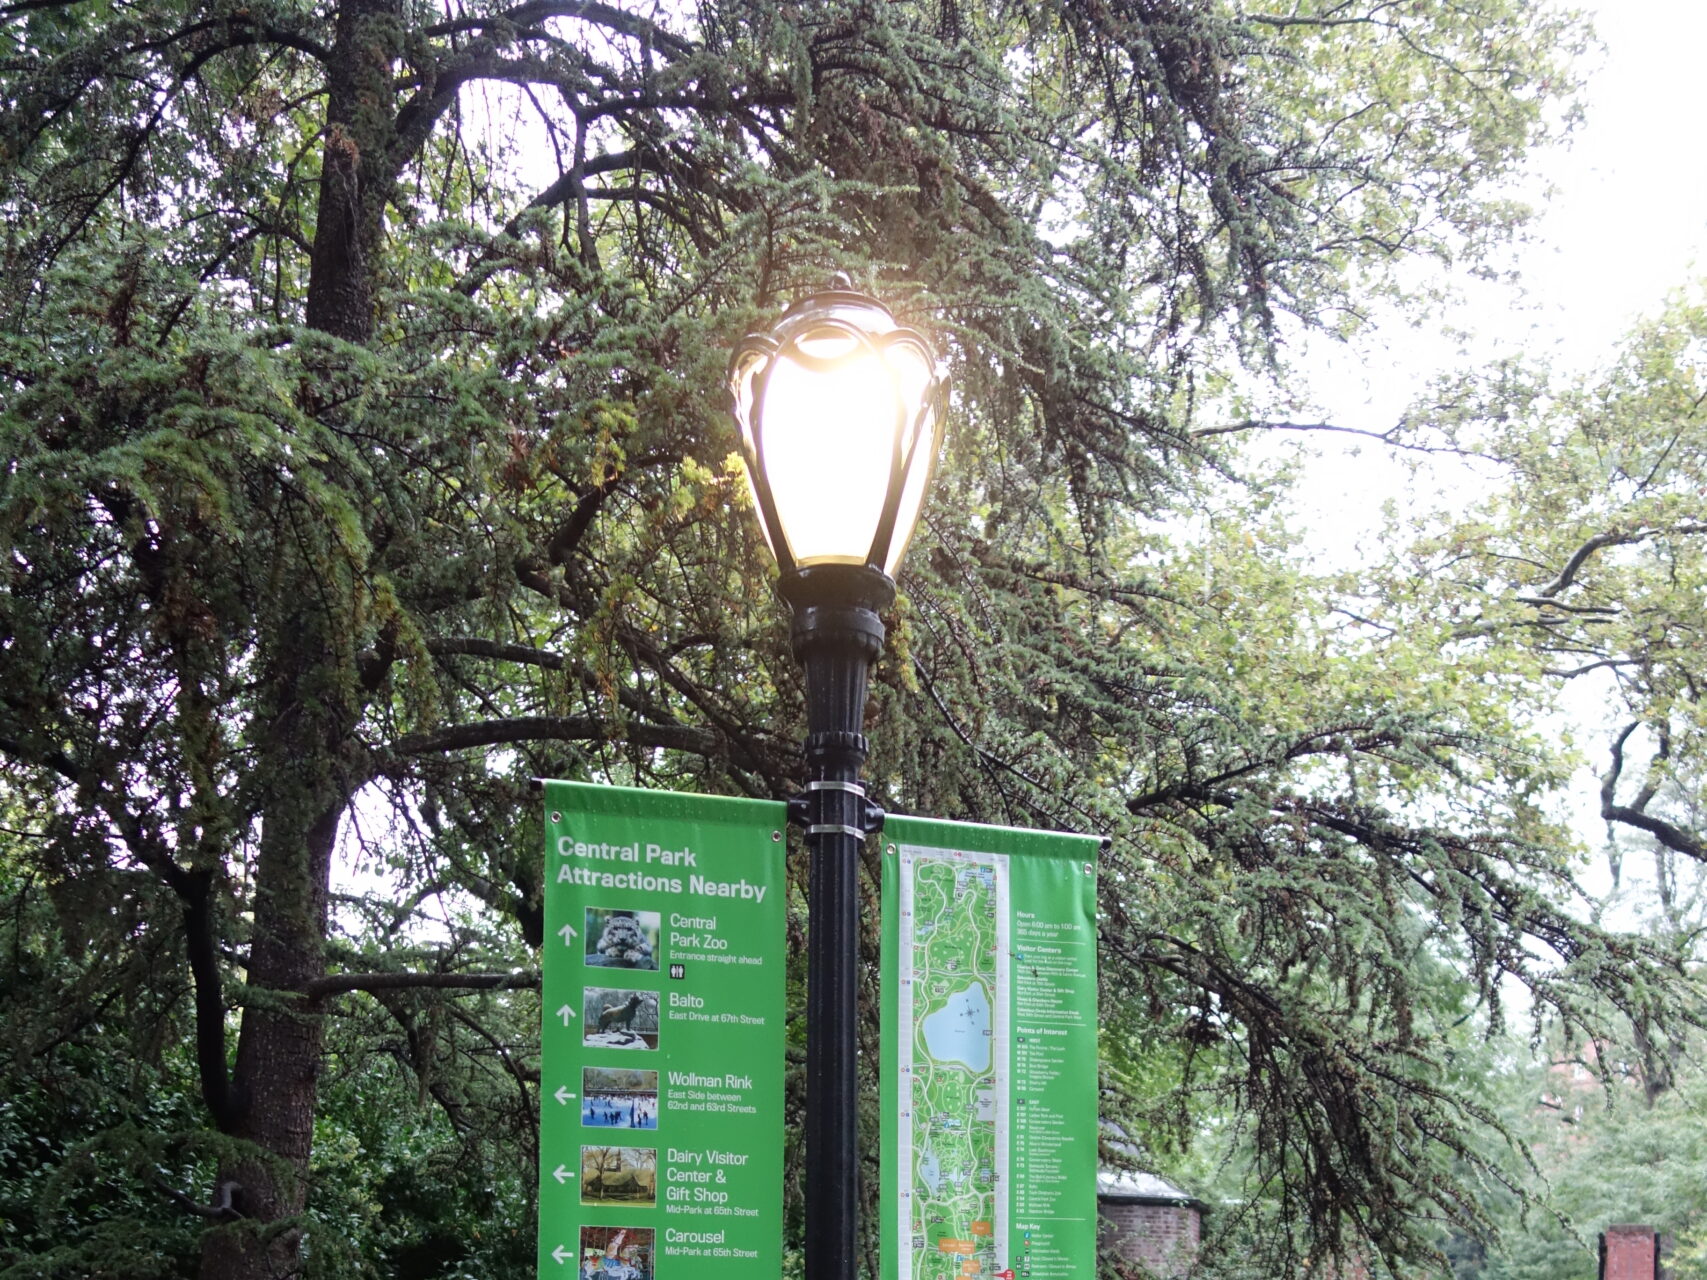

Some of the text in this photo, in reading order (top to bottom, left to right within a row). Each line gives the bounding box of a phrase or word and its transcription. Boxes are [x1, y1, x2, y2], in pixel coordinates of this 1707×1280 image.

[558, 837, 696, 867] Central Park
[557, 864, 766, 903] Attractions Nearby
[670, 913, 716, 930] Central
[1017, 910, 1035, 918] Hours
[671, 932, 727, 949] Park Zoo
[670, 950, 762, 964] Entrance straight ahead
[1037, 946, 1062, 954] Centers
[670, 992, 704, 1008] Balto
[669, 1010, 687, 1019] East
[689, 1012, 709, 1021] Drive
[721, 1014, 739, 1023] 67th
[740, 1015, 764, 1024] Street
[1017, 1026, 1035, 1034] Points
[669, 1072, 752, 1089] Wollman Rink
[668, 1089, 741, 1101] East Side between
[668, 1100, 756, 1113] 62nd and 63rd Streets
[668, 1148, 748, 1165] Dairy Visitor
[667, 1168, 726, 1183] Center &
[667, 1186, 728, 1204] Gift Shop
[666, 1205, 702, 1214] Mid-Park
[714, 1206, 732, 1215] 65th
[734, 1207, 758, 1216] Street
[666, 1228, 724, 1243] Carousel
[665, 1246, 701, 1256] Mid-Park
[713, 1248, 731, 1256] 65th
[733, 1248, 757, 1257] Street
